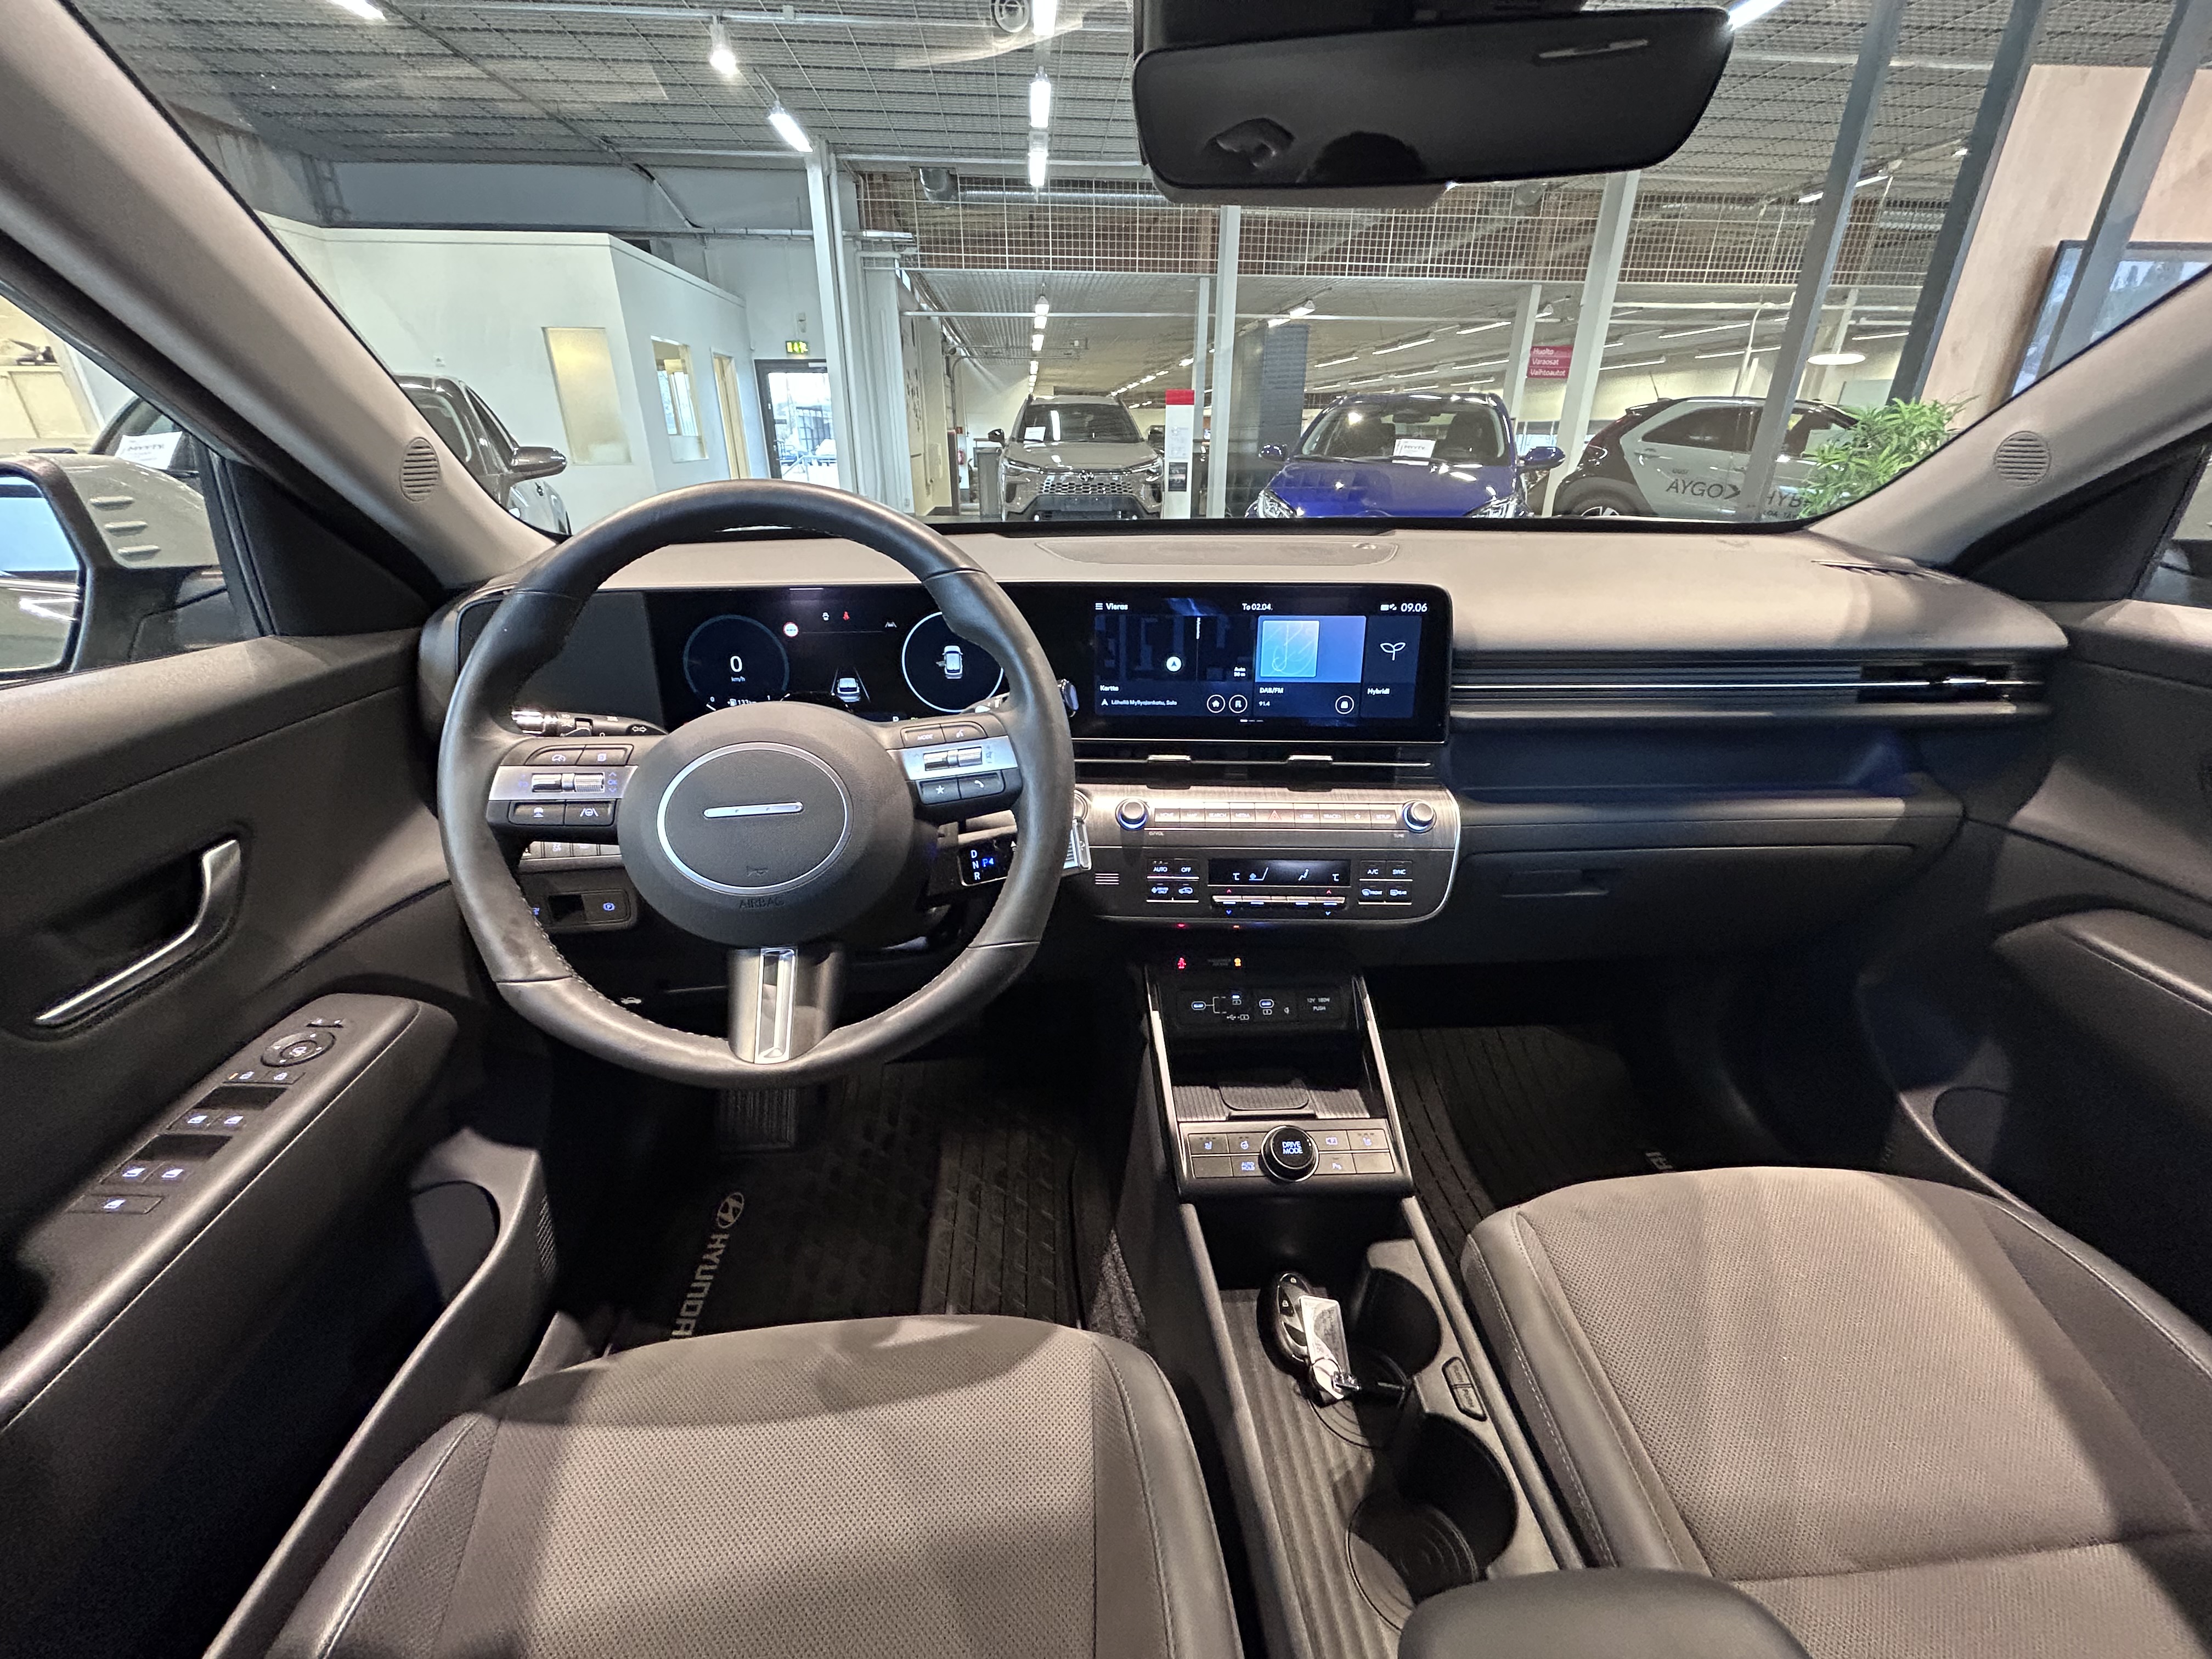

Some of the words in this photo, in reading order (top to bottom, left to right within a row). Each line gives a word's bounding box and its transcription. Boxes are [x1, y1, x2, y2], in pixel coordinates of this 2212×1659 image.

[1666, 478, 1724, 498] AYGO
[1766, 490, 1802, 508] HYB
[1401, 603, 1427, 612] 09.06
[730, 656, 742, 672] 0
[970, 850, 977, 858] D
[972, 860, 979, 869] N
[974, 872, 980, 880] R
[739, 896, 786, 909] AIRBAG
[672, 1234, 730, 1337] HYUNDA
